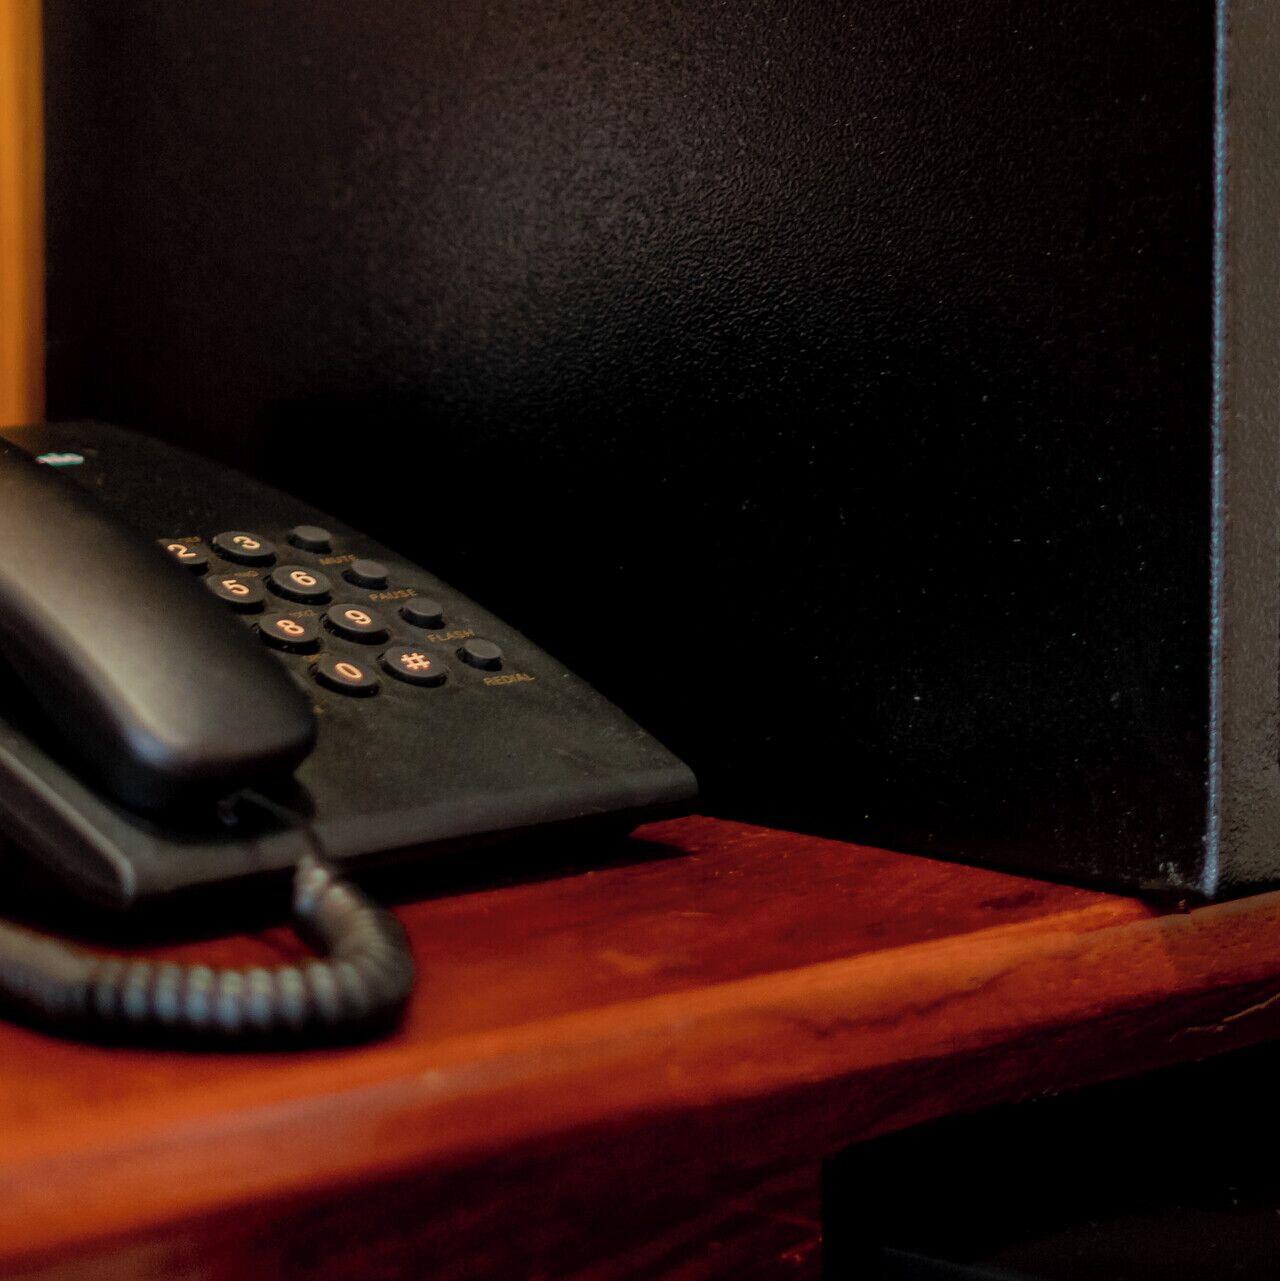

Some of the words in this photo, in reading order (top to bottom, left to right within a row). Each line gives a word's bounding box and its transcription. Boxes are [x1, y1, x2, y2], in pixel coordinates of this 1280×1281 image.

[166, 543, 197, 559] 2
[232, 535, 262, 550] 3
[289, 569, 318, 587] 6
[221, 579, 250, 596] 5
[343, 609, 372, 626] 9
[275, 618, 305, 637] 8
[334, 662, 363, 680] 0
